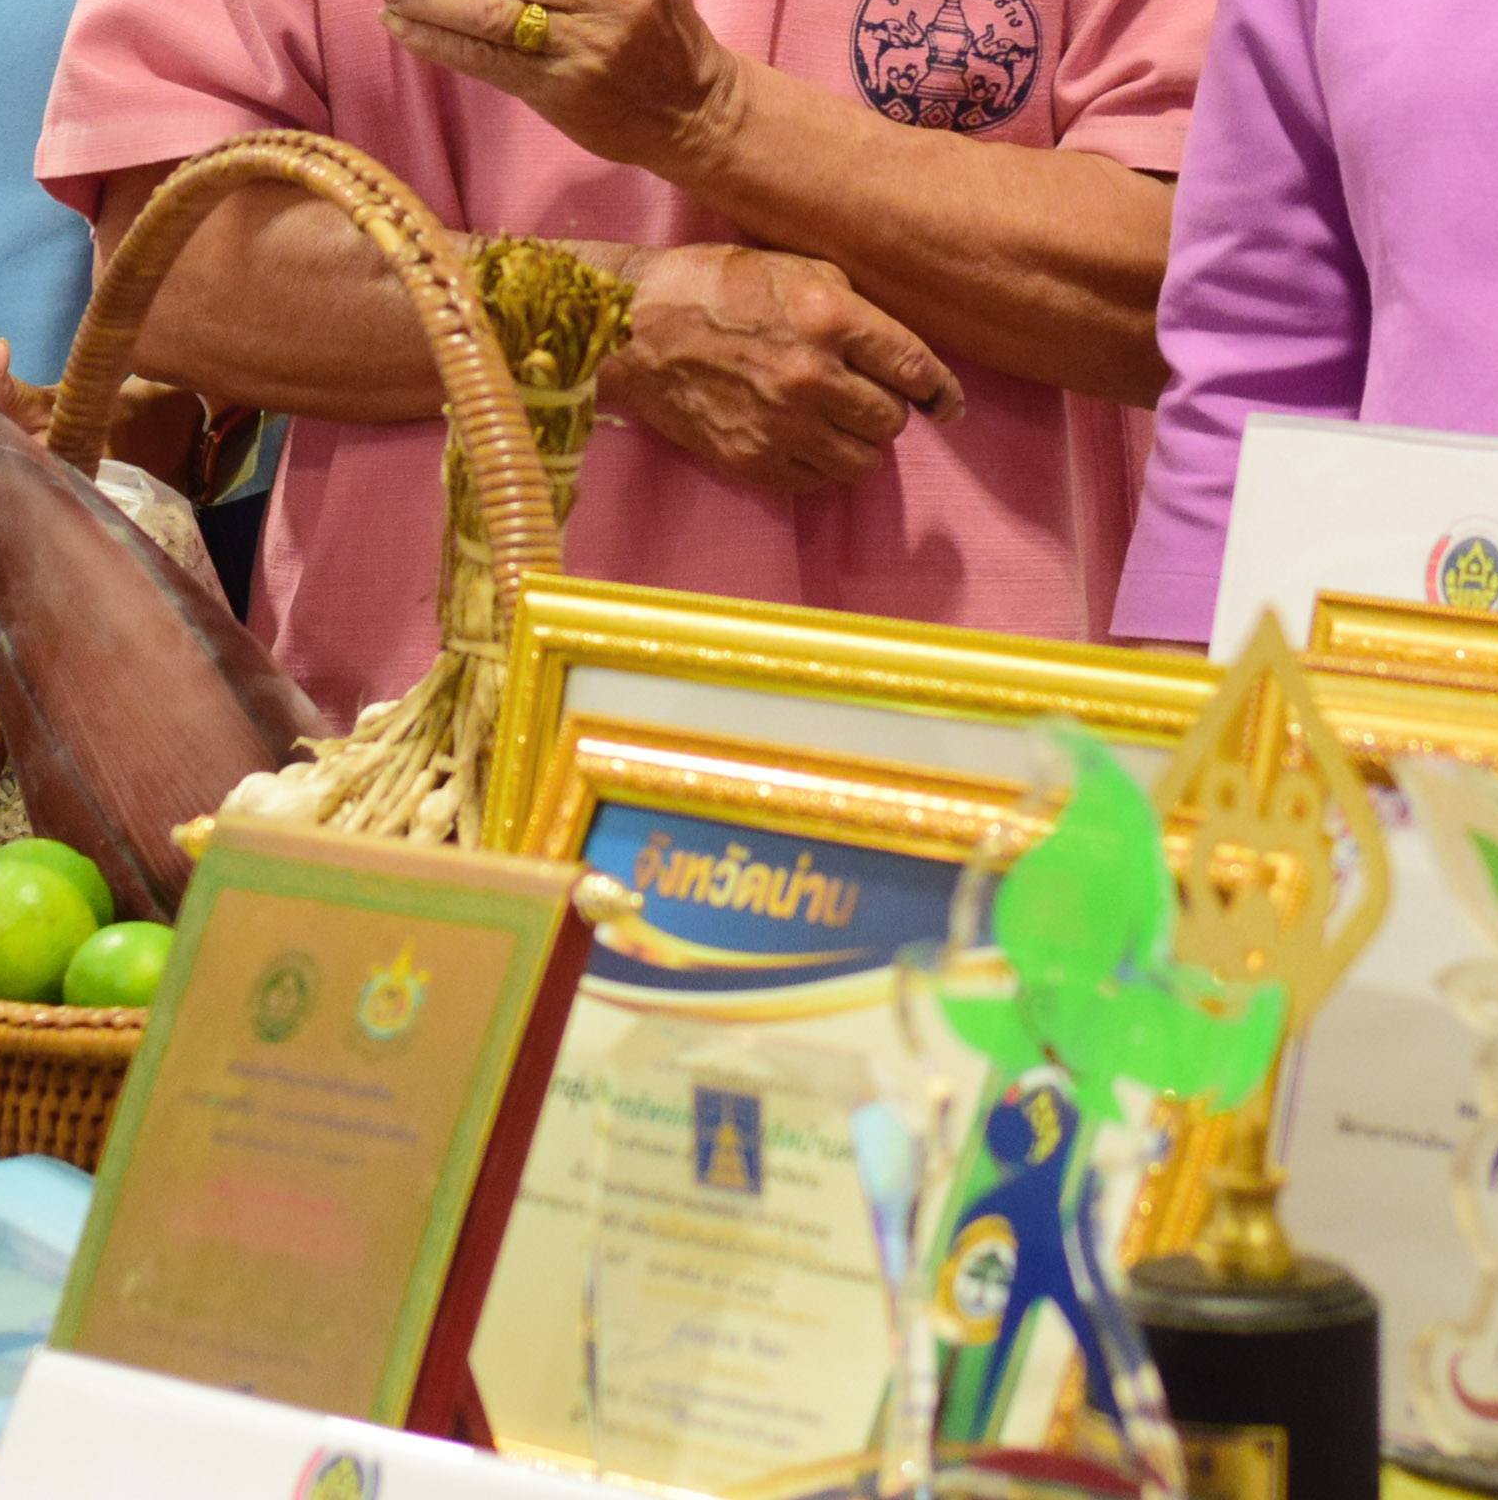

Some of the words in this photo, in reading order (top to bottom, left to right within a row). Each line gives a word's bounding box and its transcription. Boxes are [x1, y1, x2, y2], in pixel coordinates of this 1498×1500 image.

[633, 829, 860, 929] จังหวัดน่าน
